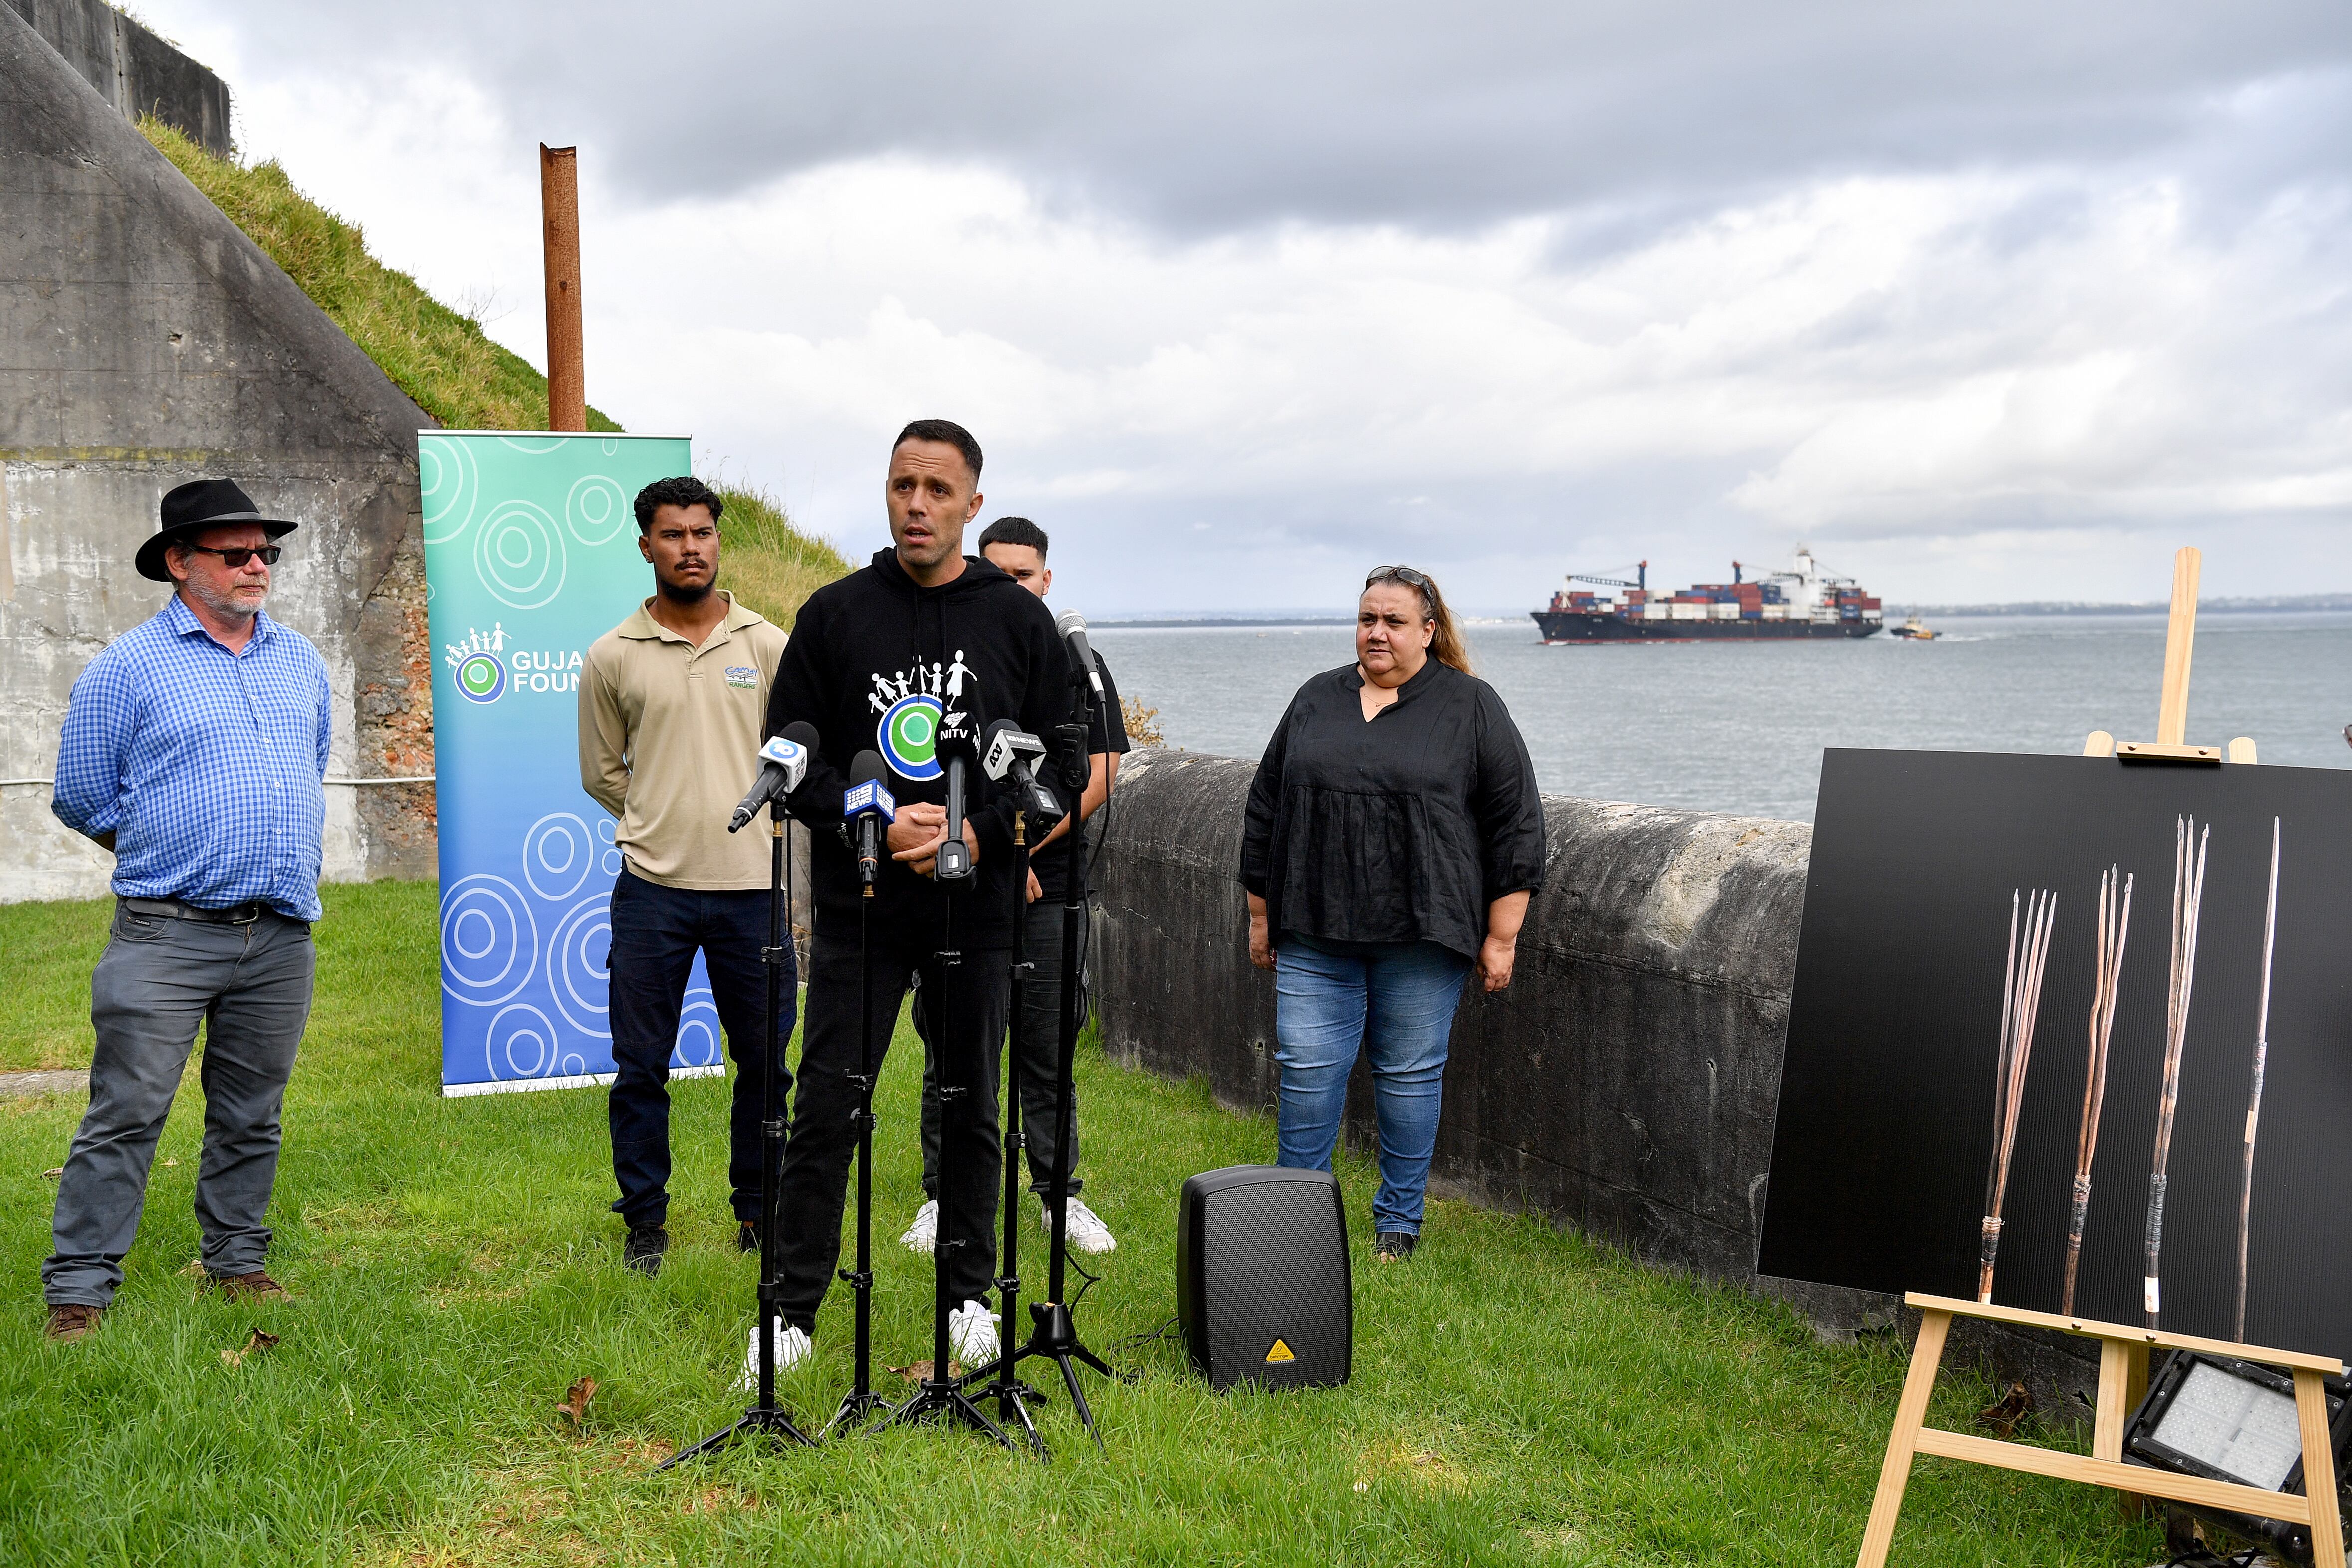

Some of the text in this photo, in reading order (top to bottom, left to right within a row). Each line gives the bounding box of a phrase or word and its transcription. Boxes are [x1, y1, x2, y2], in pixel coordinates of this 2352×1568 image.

[511, 651, 583, 671] GUJA
[725, 665, 758, 676] Gamay
[940, 728, 968, 740] NITV
[1017, 737, 1041, 746] NEWS
[773, 743, 794, 756] 10
[847, 795, 873, 812] NEWS
[876, 795, 893, 817] NEWS
